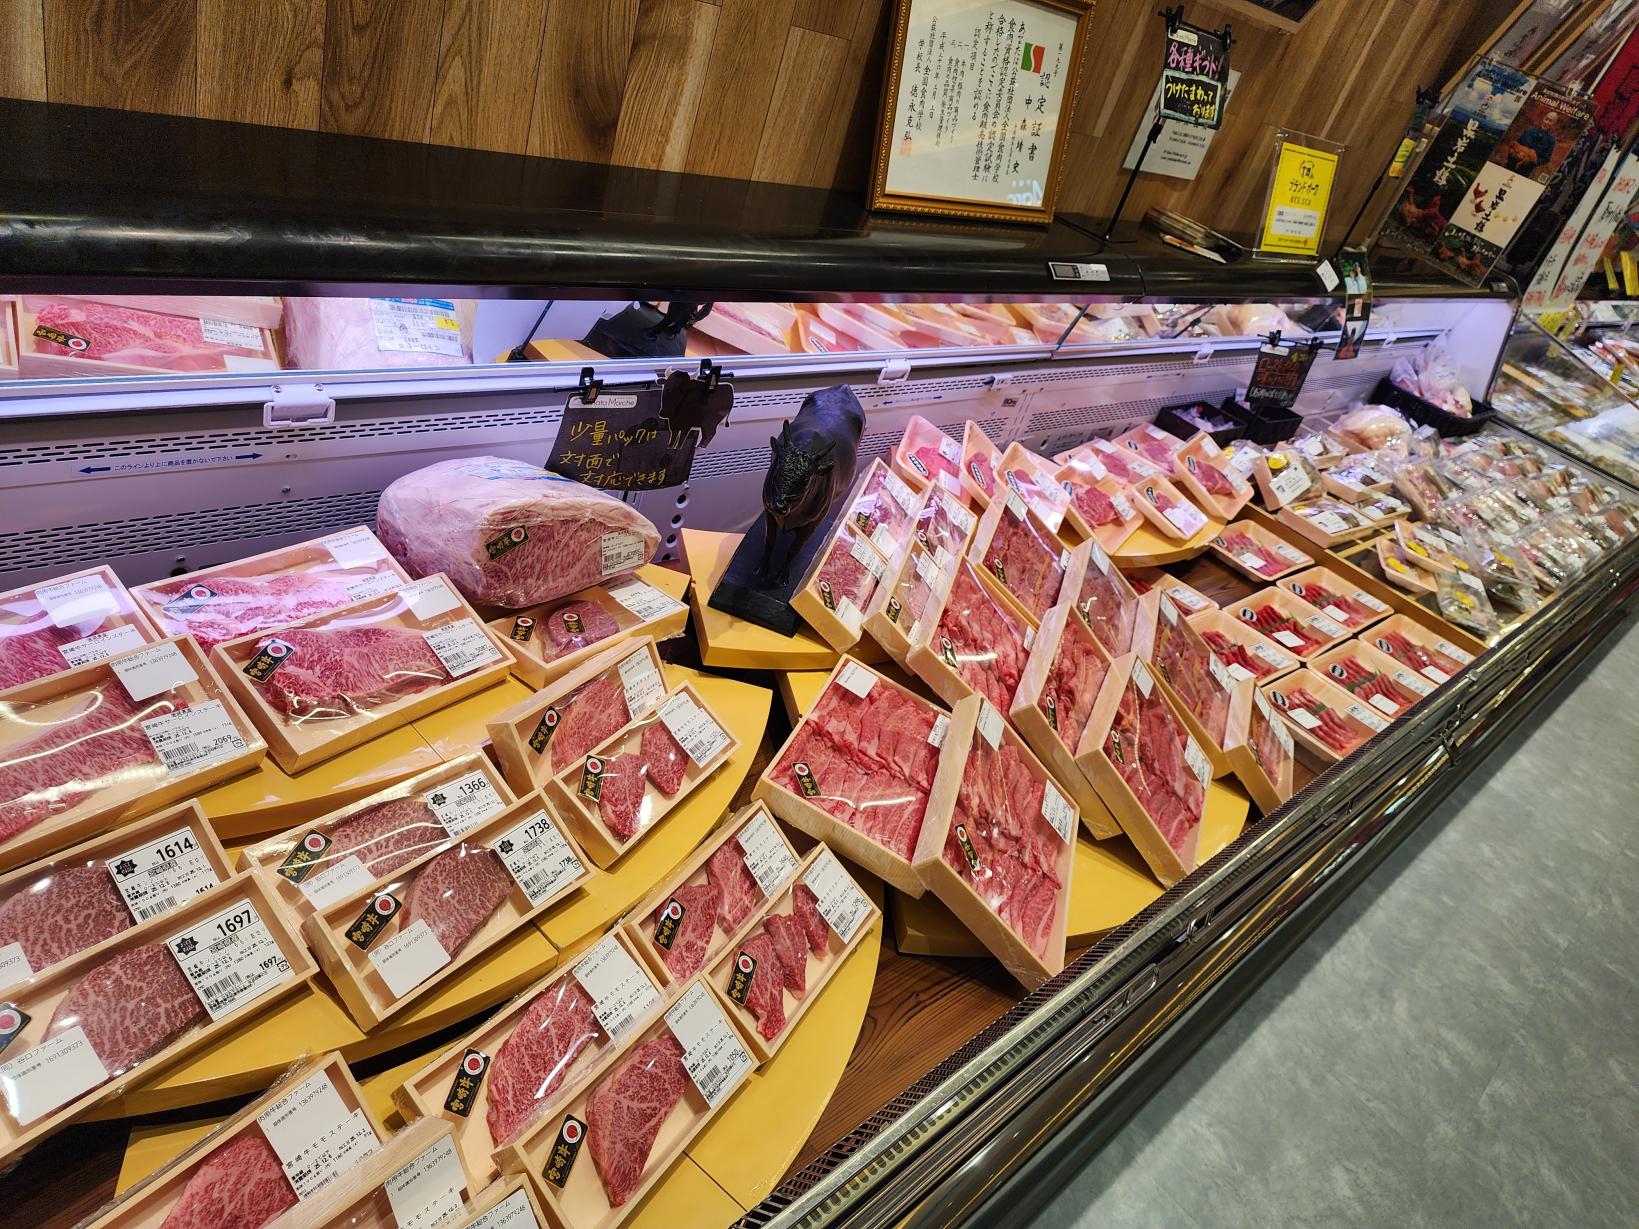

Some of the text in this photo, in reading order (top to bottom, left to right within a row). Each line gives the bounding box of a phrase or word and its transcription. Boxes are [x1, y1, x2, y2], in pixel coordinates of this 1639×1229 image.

[1166, 76, 1213, 101] うけたまわって
[1531, 92, 1559, 107] Animal
[1559, 101, 1590, 120] Welfare
[608, 398, 635, 406] Marche
[570, 421, 657, 446] 少量パックは
[114, 455, 233, 471] このラインより上に商品を置かないで下さい
[560, 450, 620, 470] 対面で
[579, 469, 667, 487] 対応できます
[250, 656, 273, 676] 宮崎牛
[213, 734, 232, 746] 2069
[533, 726, 549, 748] 宮崎牛
[459, 776, 486, 797] 1366
[581, 774, 598, 795] 宮崎牛
[523, 817, 551, 841] 1738
[156, 836, 195, 863] 1614
[559, 855, 573, 868] 1738
[216, 909, 254, 939] 1697
[352, 913, 380, 942] 宮崎牛
[658, 919, 673, 945] 宮崎牛
[259, 955, 278, 972] 1697
[731, 973, 745, 998] 宮崎牛
[16, 1037, 64, 1065] 谷口ファーム
[45, 1039, 84, 1064] 1691309373
[726, 1048, 740, 1064] 1050
[256, 1080, 312, 1123] 肉用牛総合ファーム
[297, 1081, 329, 1108] 1363979248
[450, 1077, 473, 1110] 宮崎牛
[285, 1111, 361, 1170] 宮崎牛モモステーキ
[384, 1145, 439, 1187] 肉用牛総合ファーム
[422, 1147, 453, 1173] 1363979248
[549, 1144, 570, 1179] 宮崎牛
